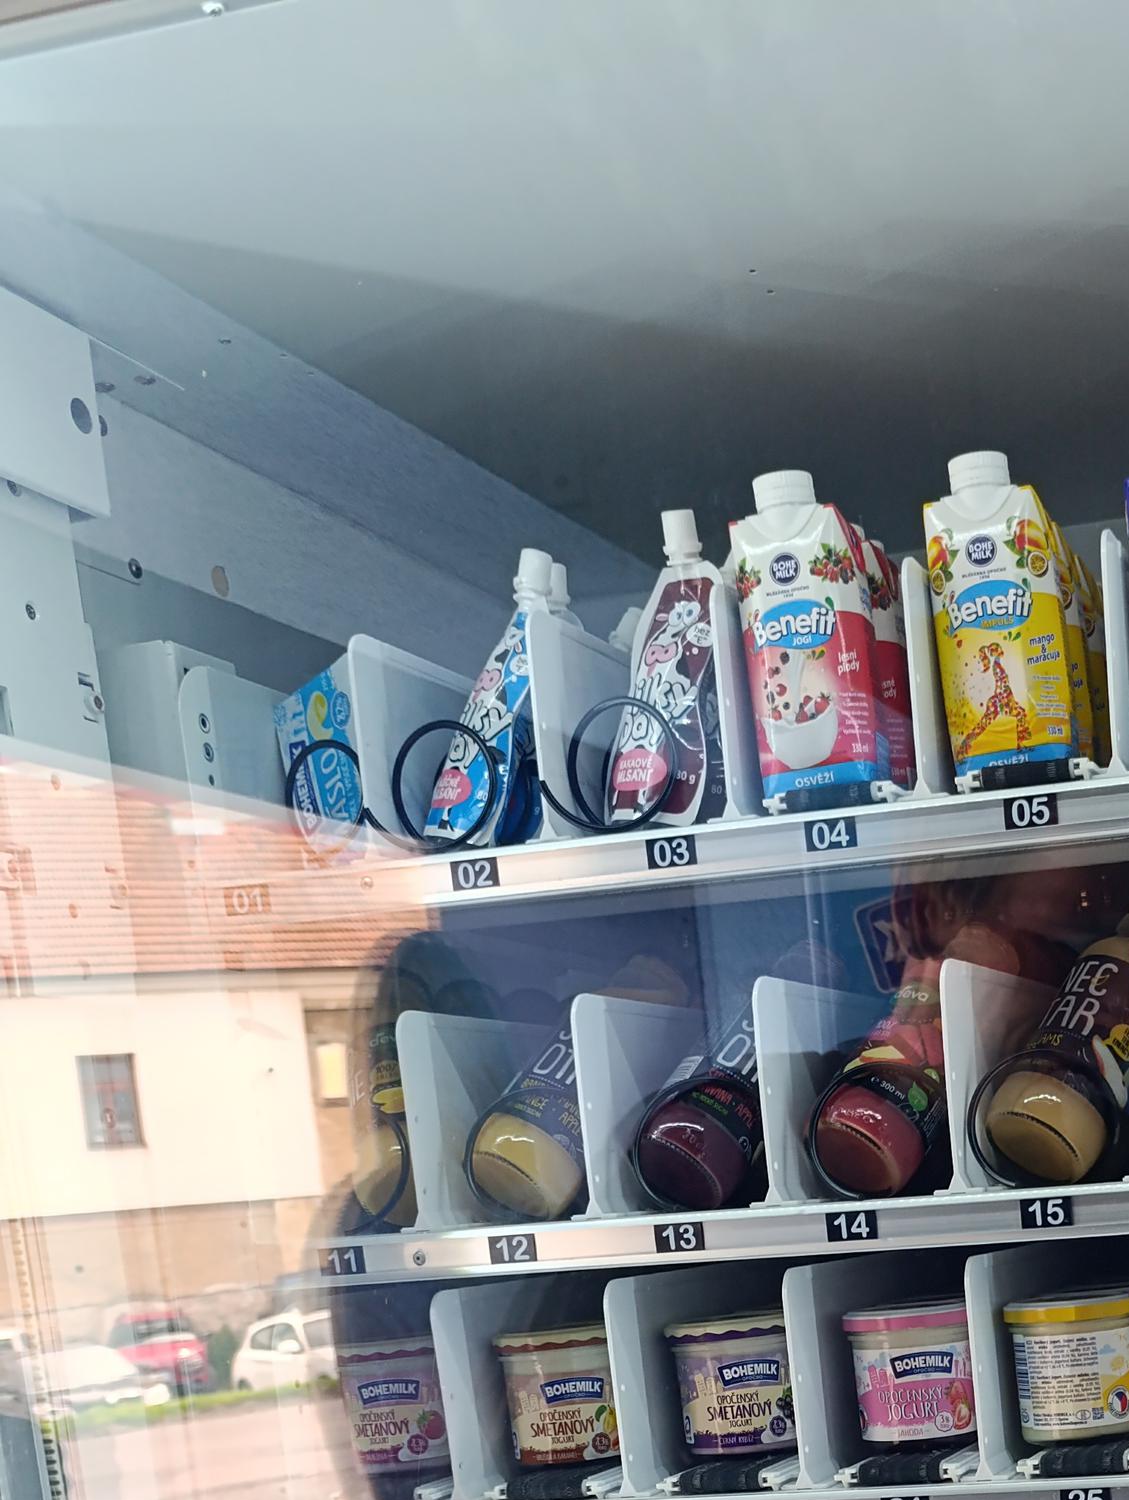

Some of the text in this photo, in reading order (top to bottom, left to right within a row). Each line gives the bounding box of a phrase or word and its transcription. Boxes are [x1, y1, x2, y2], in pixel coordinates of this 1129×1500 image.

[971, 548, 992, 561] MILK
[774, 568, 797, 580] MILK
[947, 590, 1033, 629] Benefit
[753, 607, 837, 647] Benefit
[1029, 633, 1055, 647] mango
[1027, 650, 1060, 665] maracuja
[1011, 797, 1050, 827] 05
[811, 819, 850, 850] 04
[653, 838, 690, 867] 03
[457, 860, 493, 889] 02
[1028, 1198, 1065, 1227] 15
[662, 1224, 696, 1250] 13
[833, 1212, 870, 1240] 14
[495, 1235, 530, 1261] 12
[328, 1249, 358, 1274] 11
[722, 1361, 778, 1381] BOHEMILK
[894, 1354, 951, 1374] BOHEMILK
[361, 1381, 417, 1400] BOHEMILK
[545, 1380, 601, 1399] BOHEMILK
[707, 1399, 772, 1421] SMETANOVÝ
[886, 1400, 940, 1422] JOGURT
